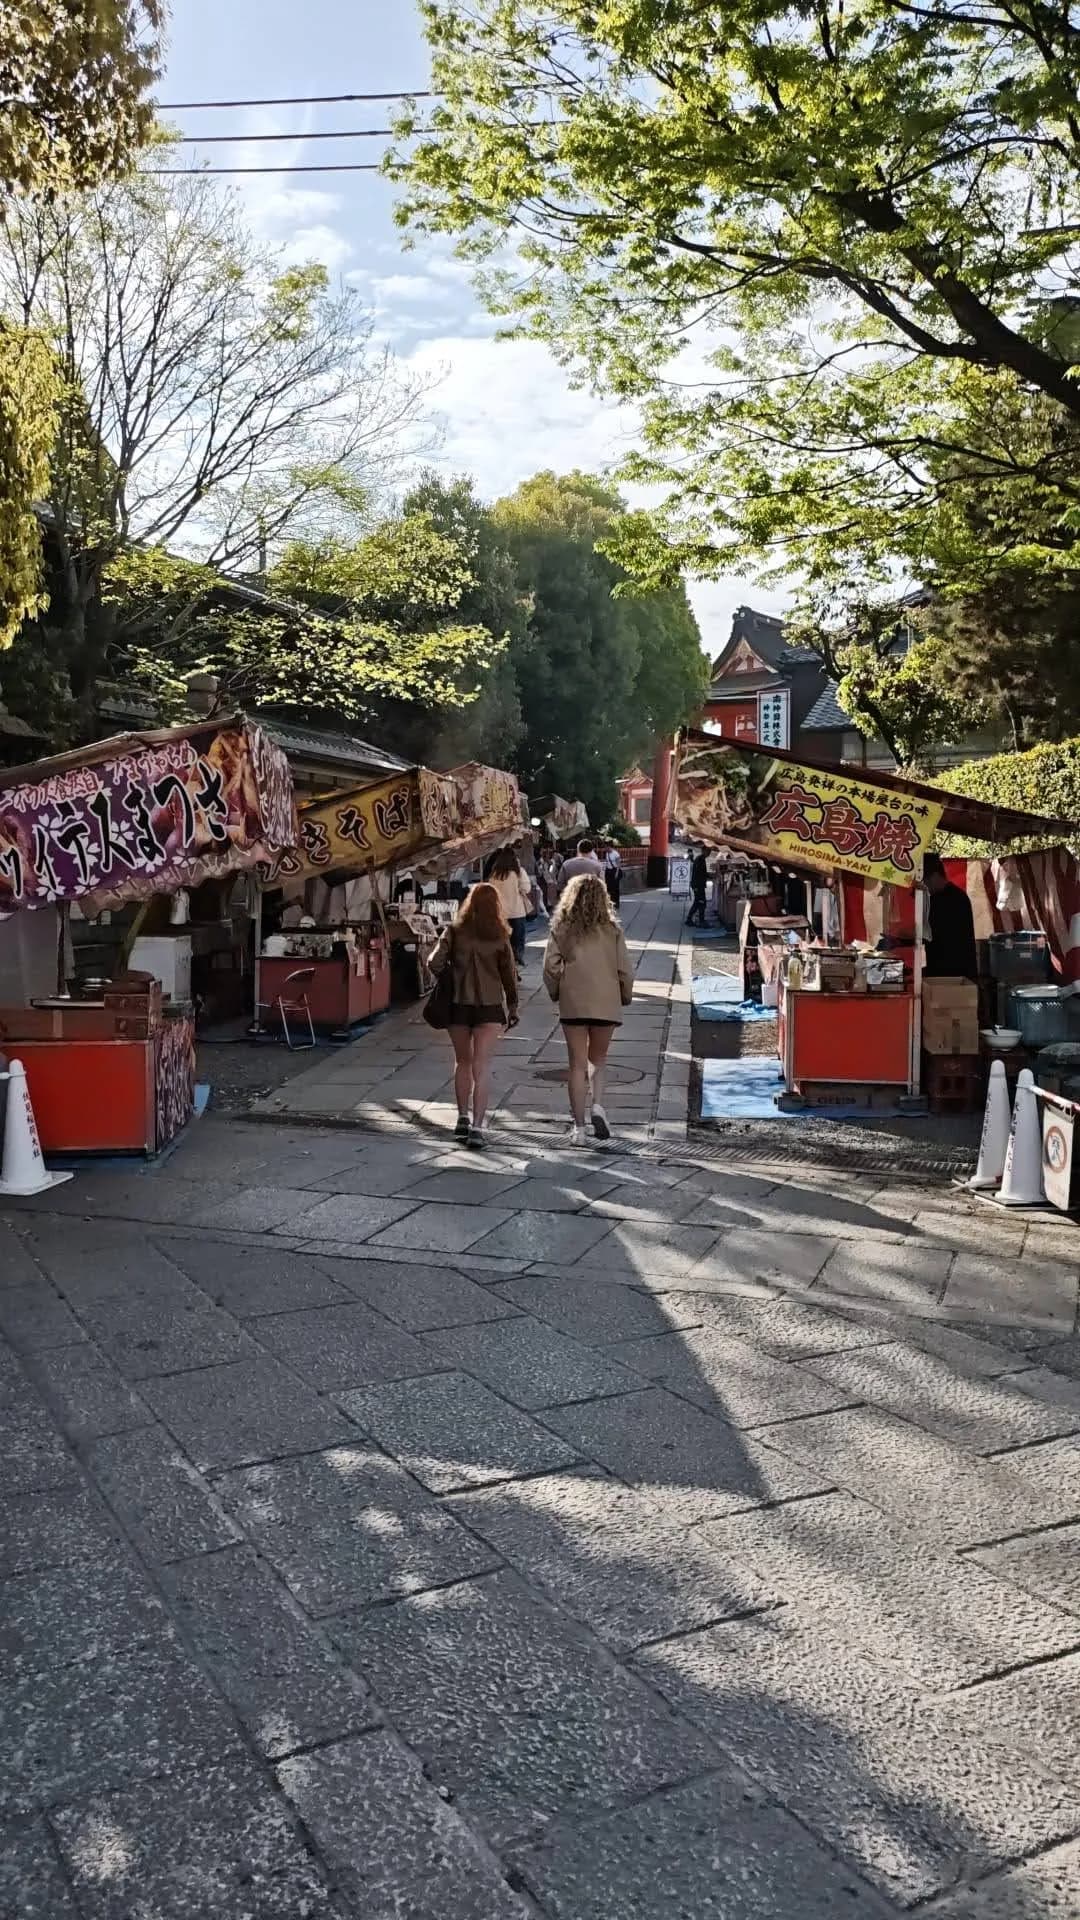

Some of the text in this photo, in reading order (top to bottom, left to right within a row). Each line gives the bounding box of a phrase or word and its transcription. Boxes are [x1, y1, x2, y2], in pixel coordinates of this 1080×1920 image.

[779, 766, 930, 818] 広島発祥の本場屋台の味
[262, 786, 412, 882] やきそば
[759, 784, 922, 872] 広島焼
[789, 844, 873, 874] HIROSIMA-YAKI
